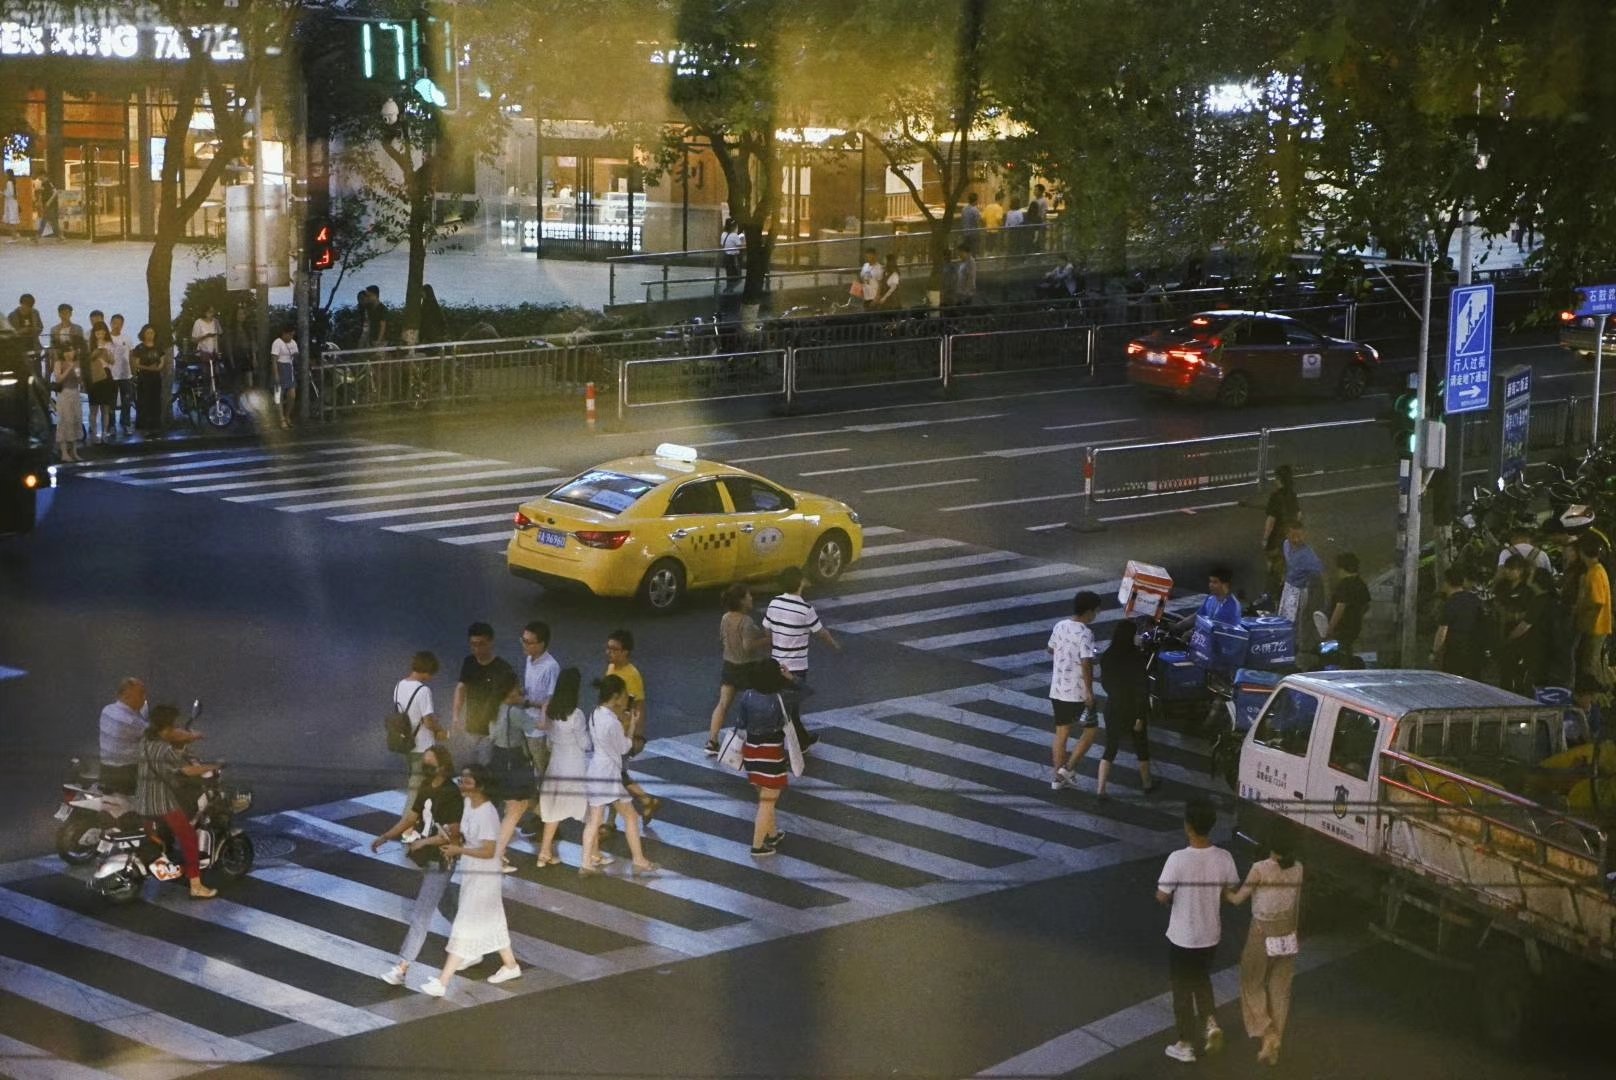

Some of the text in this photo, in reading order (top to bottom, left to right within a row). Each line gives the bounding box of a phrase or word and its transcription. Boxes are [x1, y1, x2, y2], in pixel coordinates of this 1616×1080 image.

[1590, 288, 1616, 302] 石鼓路
[1453, 356, 1486, 372] 行人过街
[1450, 371, 1487, 386] 请走地下通道
